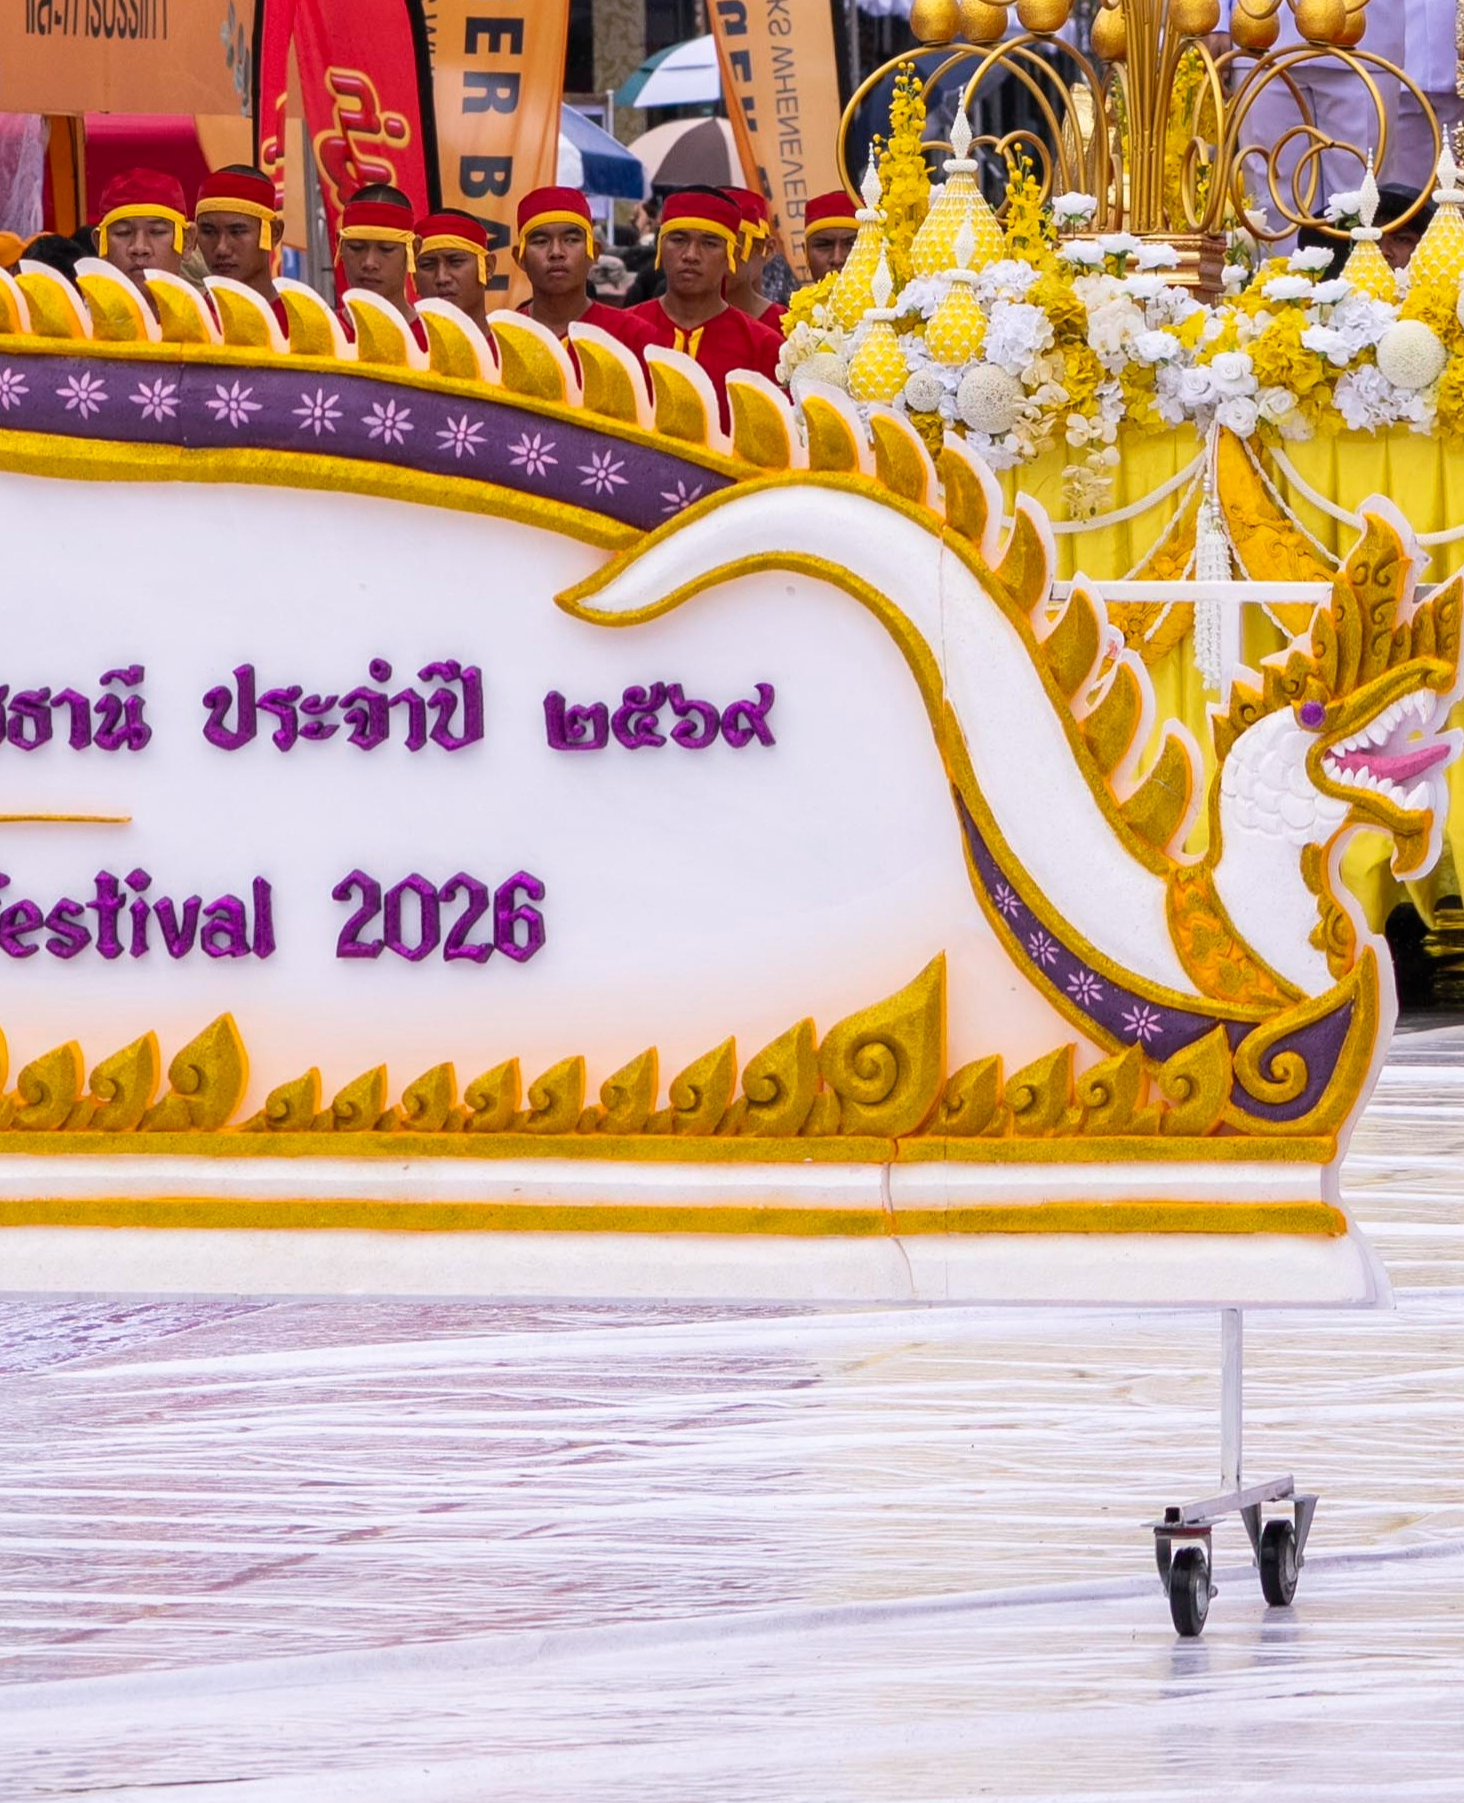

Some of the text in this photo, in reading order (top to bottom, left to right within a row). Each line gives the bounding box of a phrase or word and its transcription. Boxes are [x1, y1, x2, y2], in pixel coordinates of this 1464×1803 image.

[203, 657, 485, 753] ประจำปี
[544, 683, 776, 752] ๒๕๖๙
[333, 871, 546, 965] 2026
